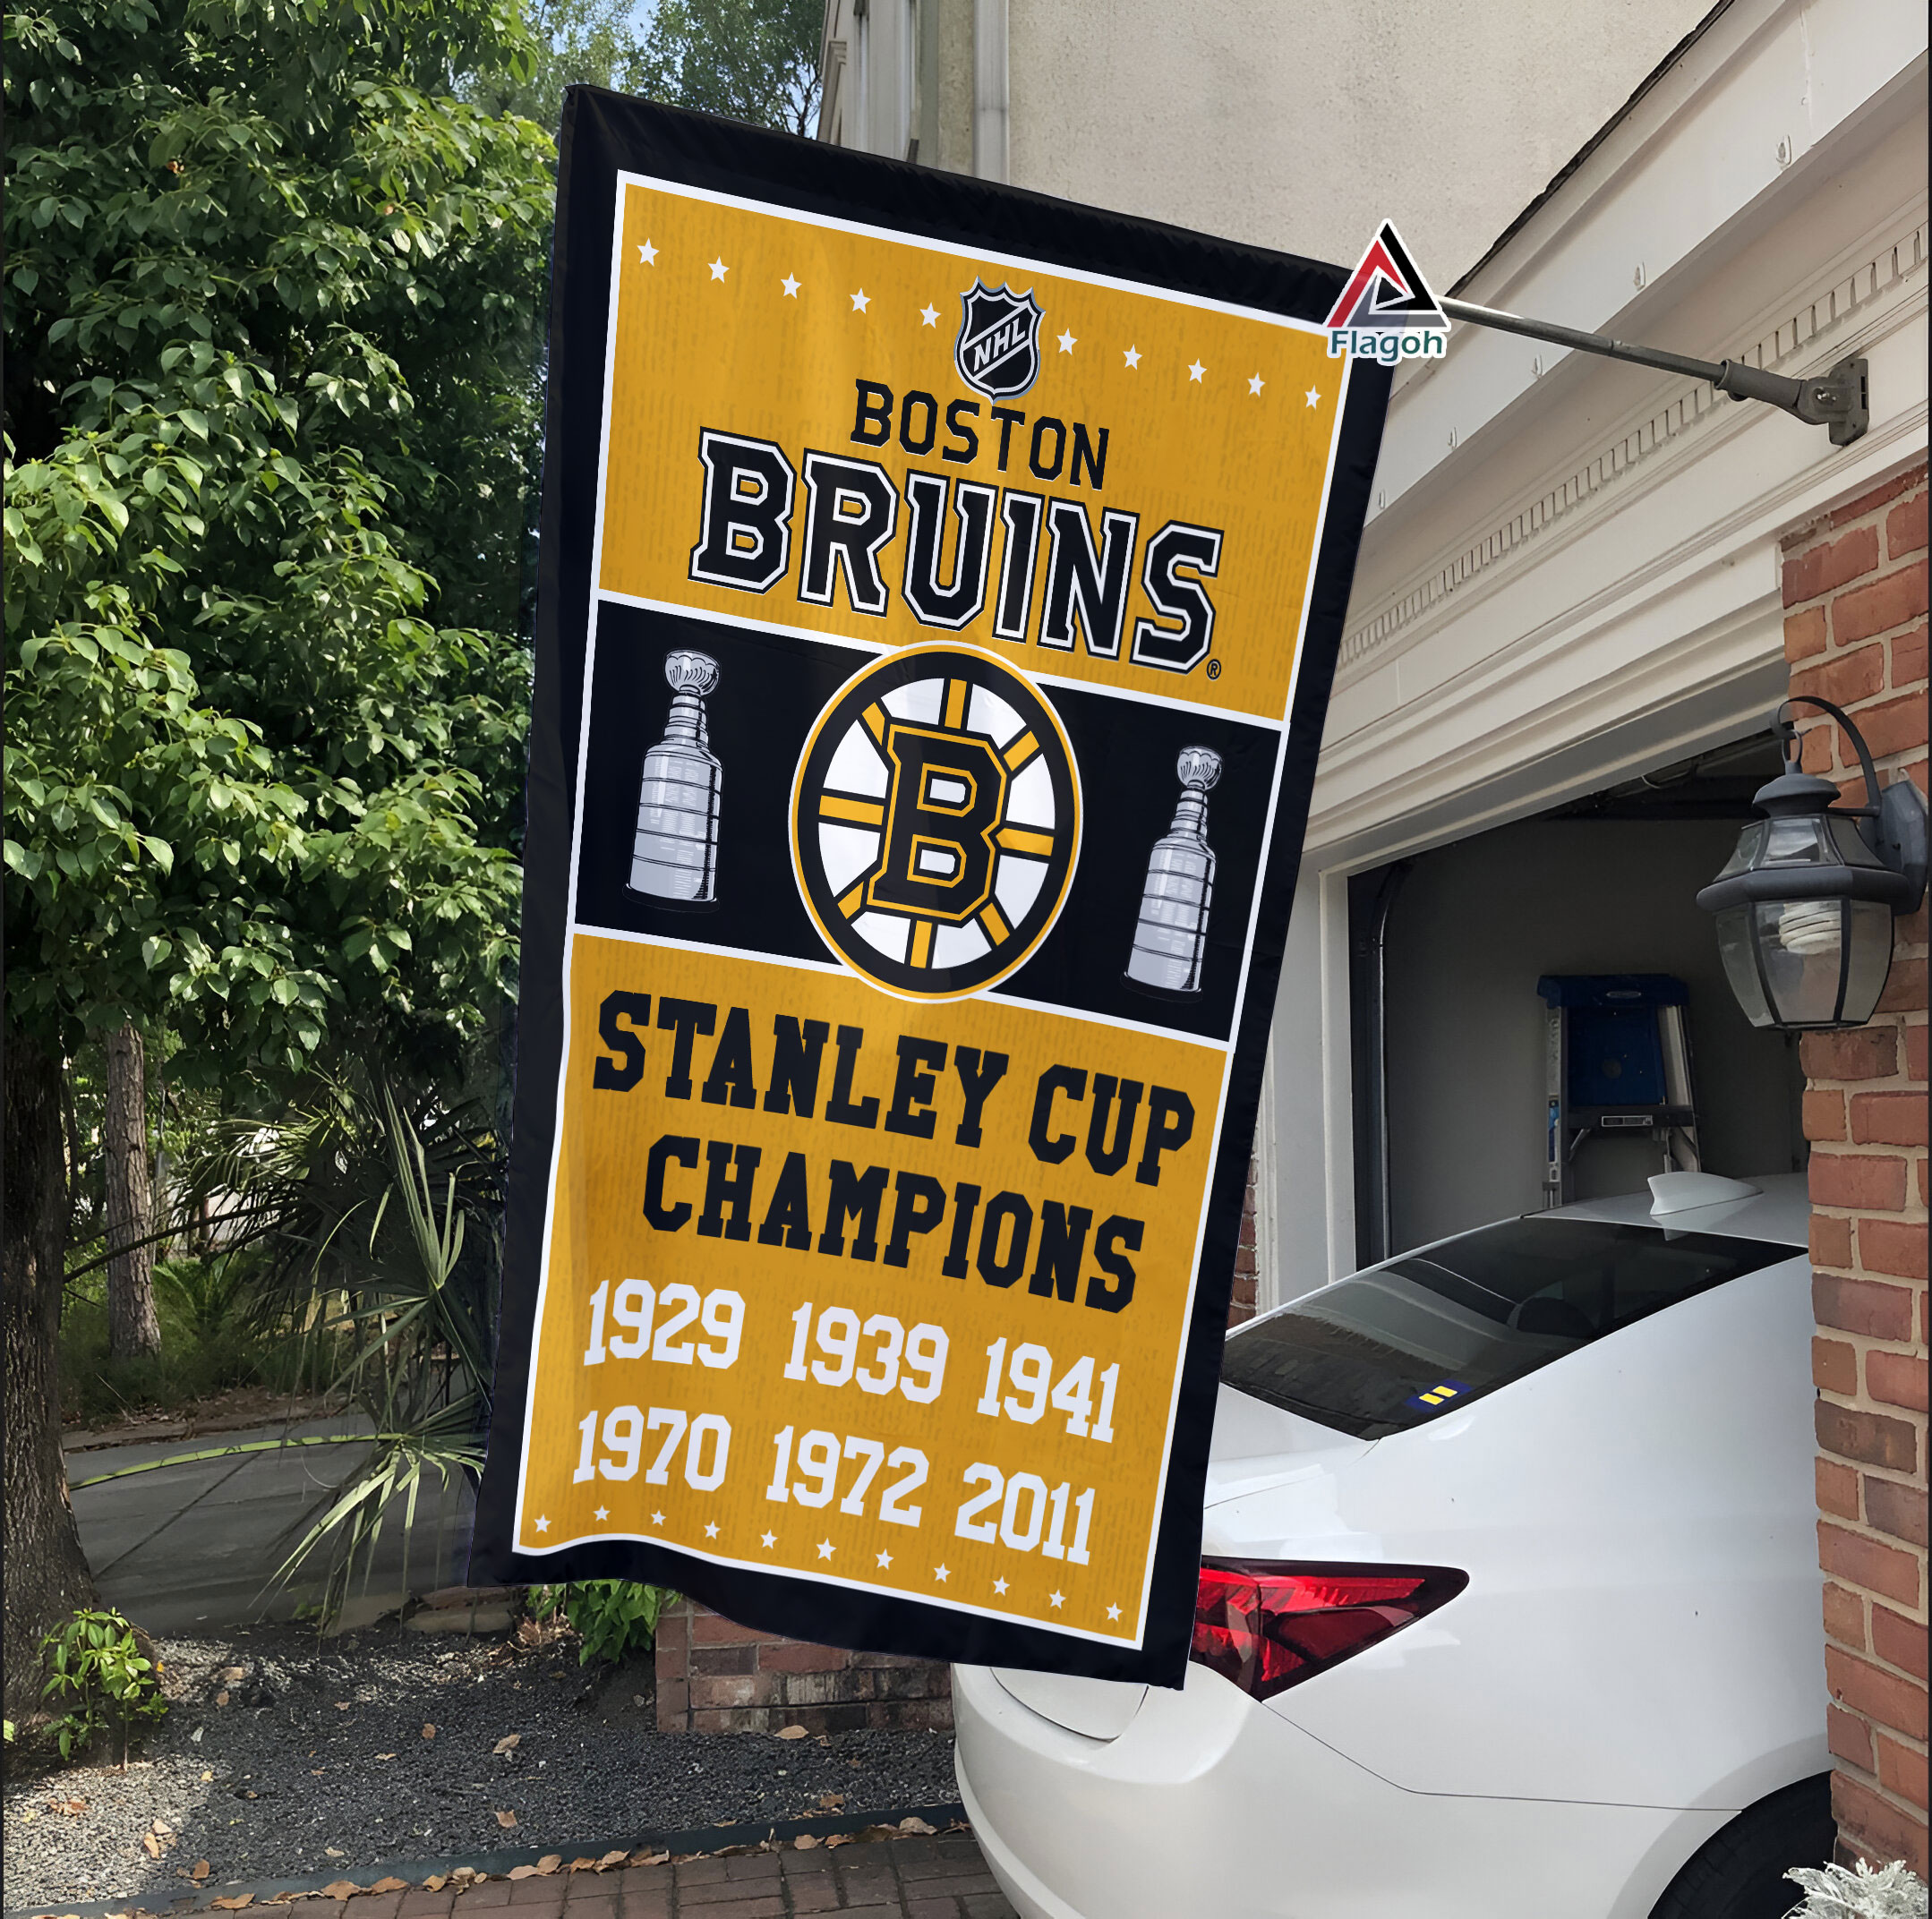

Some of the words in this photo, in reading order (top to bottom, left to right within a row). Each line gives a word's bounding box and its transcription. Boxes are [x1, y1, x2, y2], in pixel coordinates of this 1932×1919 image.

[973, 317, 1026, 372] NHL
[850, 378, 1110, 490] BOSTON
[687, 425, 1225, 675] BRUINS
[866, 723, 1007, 922] B
[593, 989, 1010, 1148] STANLEY
[1028, 1063, 1196, 1187] CUP
[642, 1134, 1145, 1314] CHAMPIONS
[583, 1278, 746, 1369] 1929
[783, 1301, 950, 1404] 1939
[977, 1336, 1121, 1444] 1941
[572, 1405, 732, 1492] 1970
[765, 1424, 930, 1528] 1972
[954, 1462, 1097, 1566] 2011
